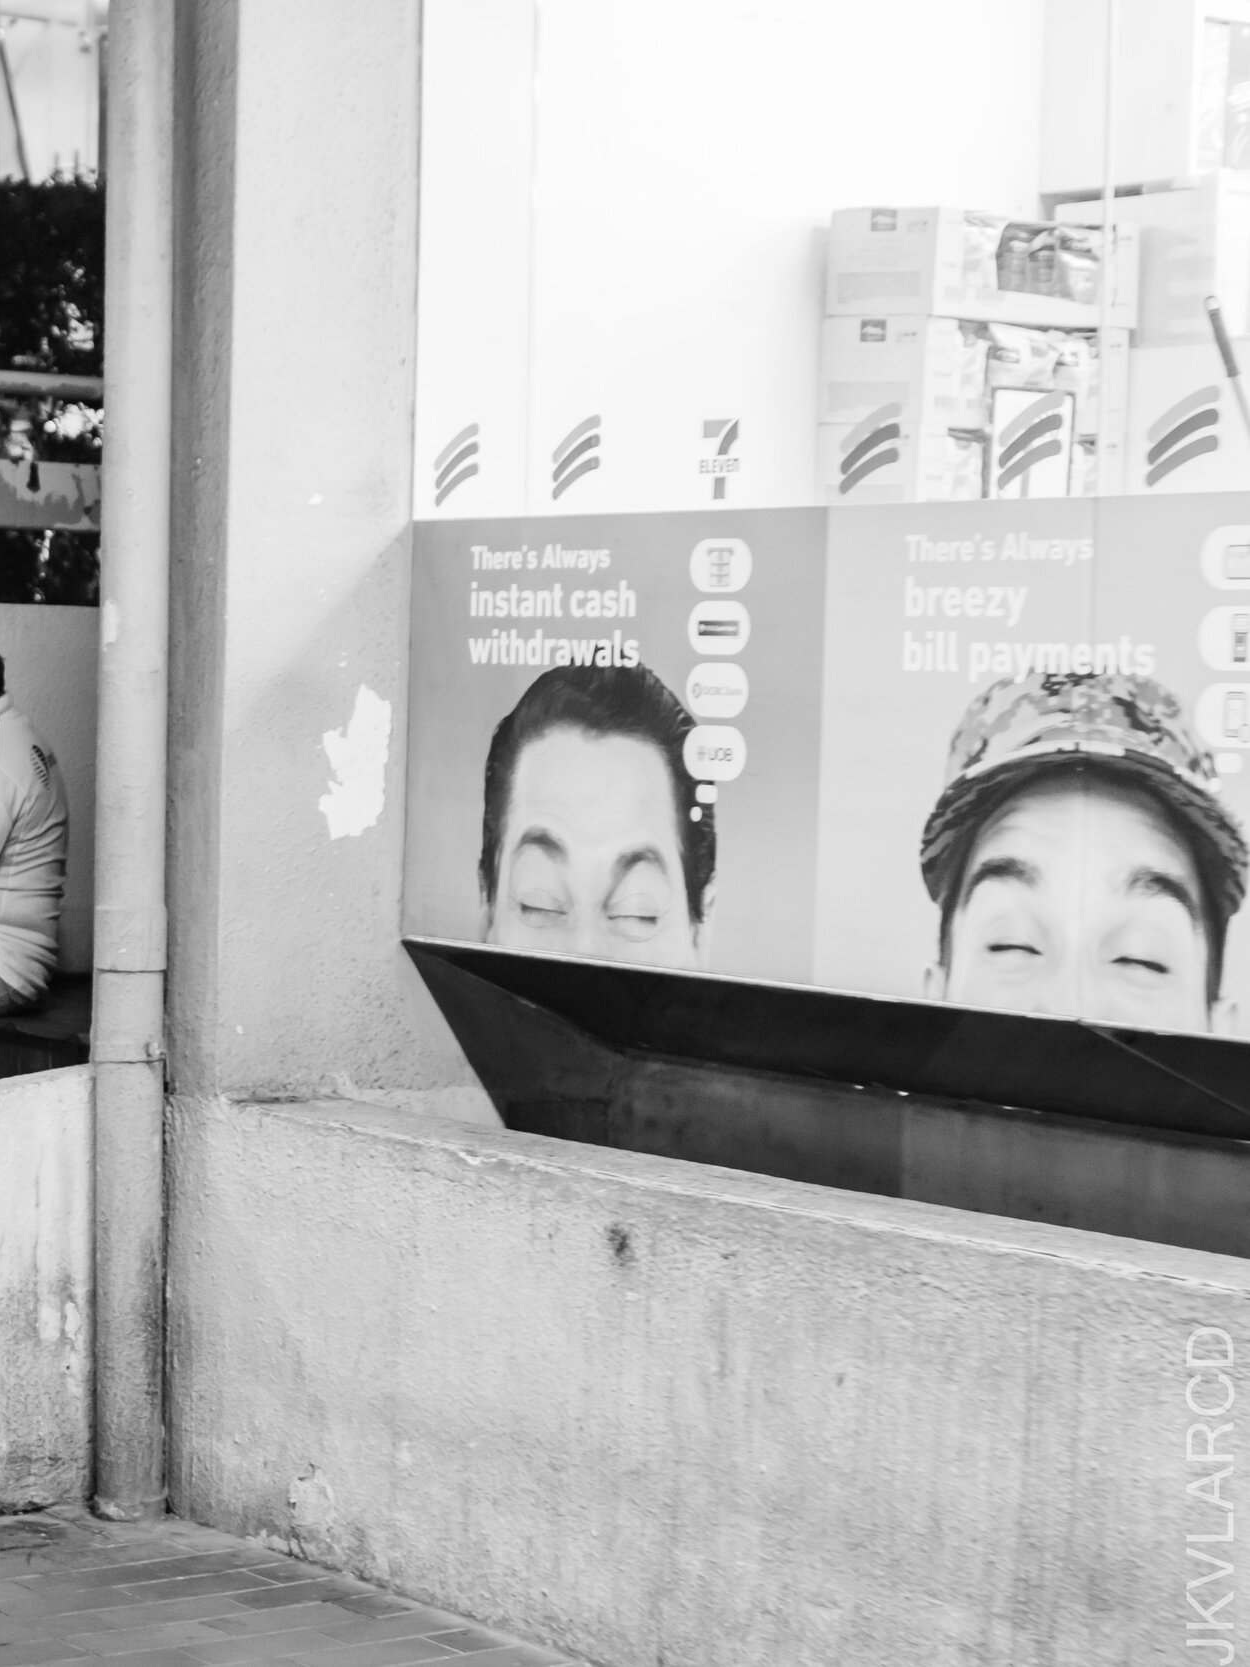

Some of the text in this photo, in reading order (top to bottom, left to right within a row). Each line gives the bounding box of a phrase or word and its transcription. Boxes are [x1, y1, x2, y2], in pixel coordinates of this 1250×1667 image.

[470, 544, 611, 574] There's Always
[905, 532, 1094, 567] There's Always
[469, 580, 636, 618] instant cash
[905, 577, 1029, 626] breezy
[469, 629, 640, 667] withdrawals
[903, 631, 1157, 682] bill payments
